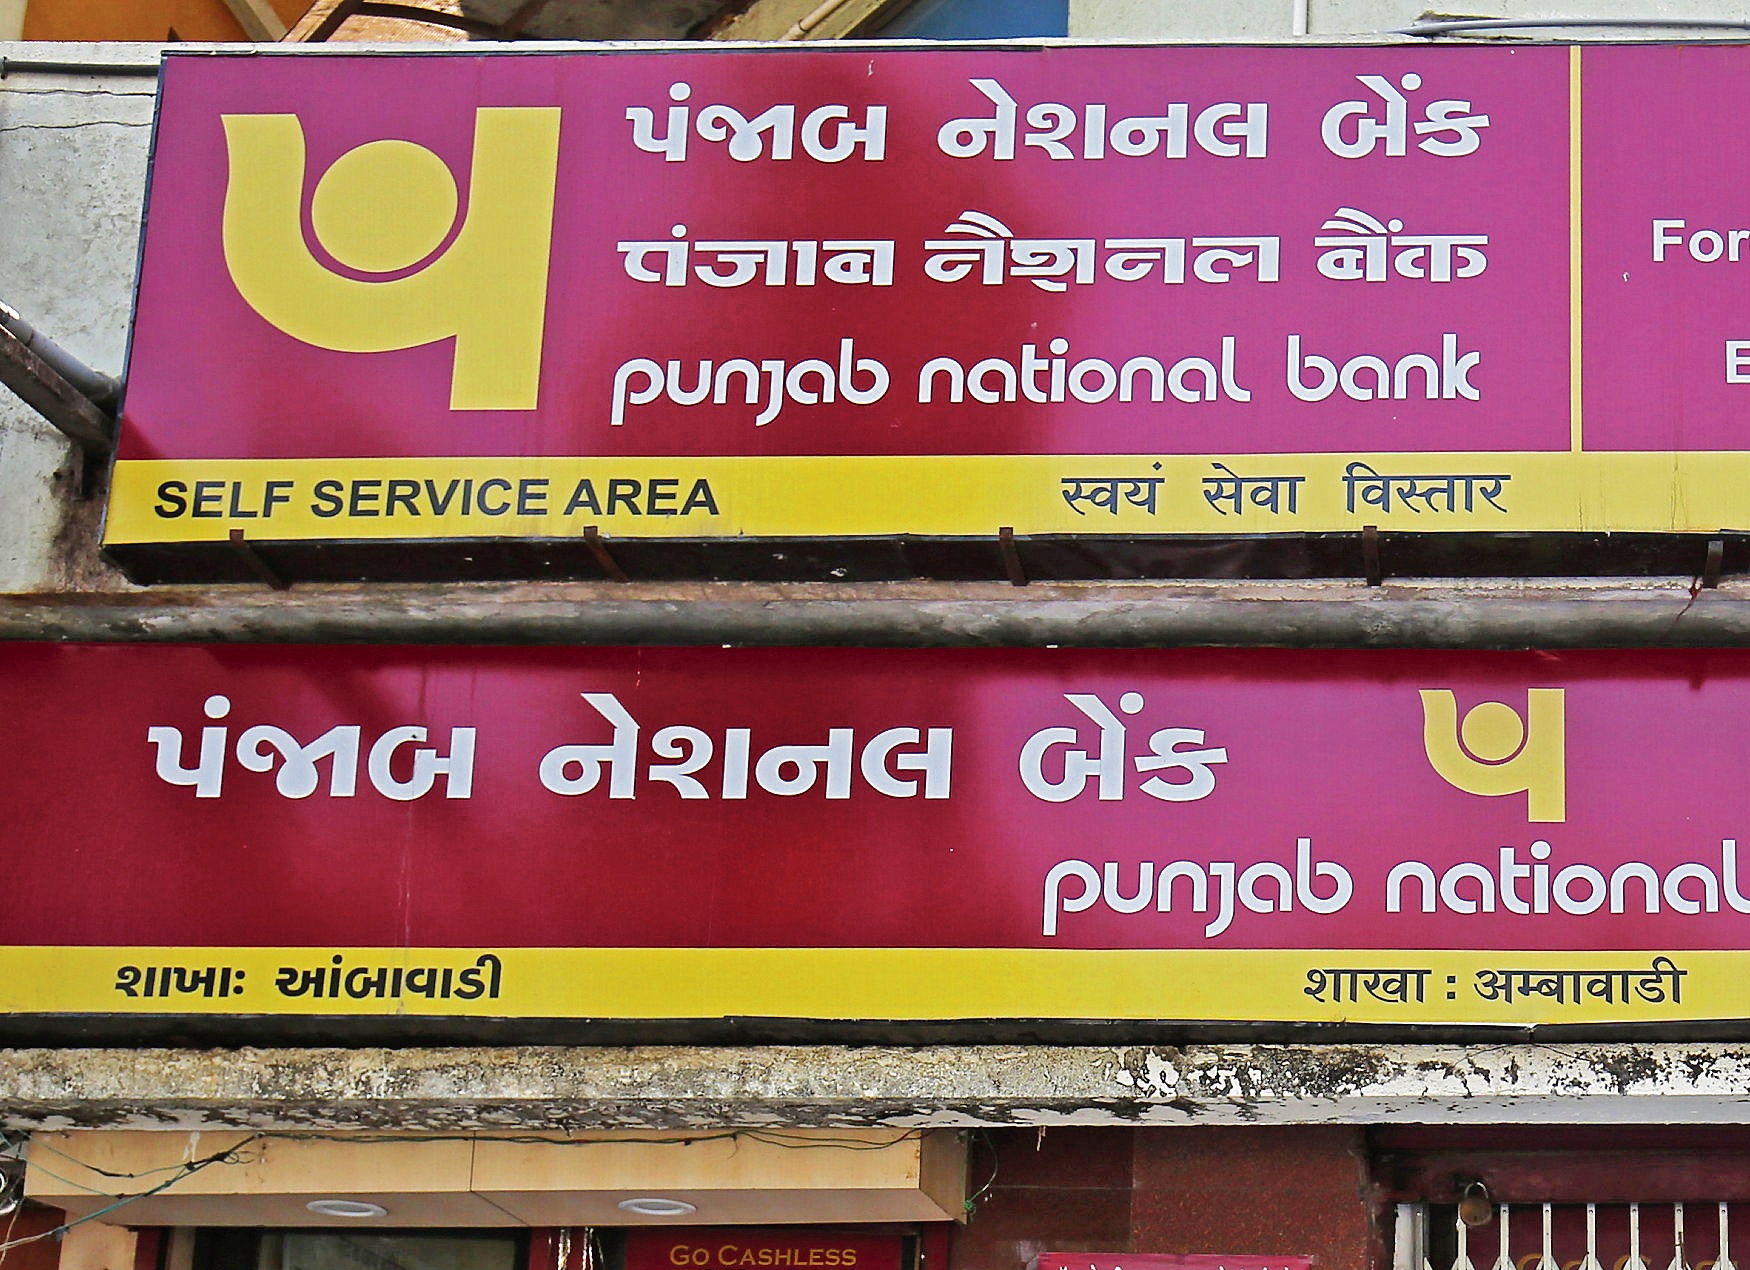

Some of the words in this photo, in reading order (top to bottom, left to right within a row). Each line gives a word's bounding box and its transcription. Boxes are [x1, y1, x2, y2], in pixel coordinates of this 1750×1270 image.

[626, 82, 888, 162] પંજાબ
[937, 79, 1268, 160] નેશનલ
[1321, 72, 1490, 158] બેંક
[617, 224, 895, 287] पंजाब
[924, 210, 1280, 291] नैशनल
[1314, 207, 1489, 283] बैंक
[610, 338, 889, 427] punjab
[917, 336, 1251, 403] national
[1285, 333, 1481, 401] bank
[154, 480, 294, 519] SELF
[310, 478, 549, 518] SERVICE
[563, 478, 720, 516] AREA
[1061, 462, 1166, 516] स्वयं
[1202, 462, 1306, 516] सेवा
[1342, 461, 1511, 514] विस्तार
[146, 695, 477, 800] પંજાબ
[539, 692, 953, 800] નેશનલ
[1019, 691, 1228, 802] બેંક
[1043, 837, 1353, 938] punjab
[274, 953, 502, 999] આંબાવાડી
[1305, 967, 1432, 1003] शाखा
[1474, 956, 1687, 1004] अम्बावाडी
